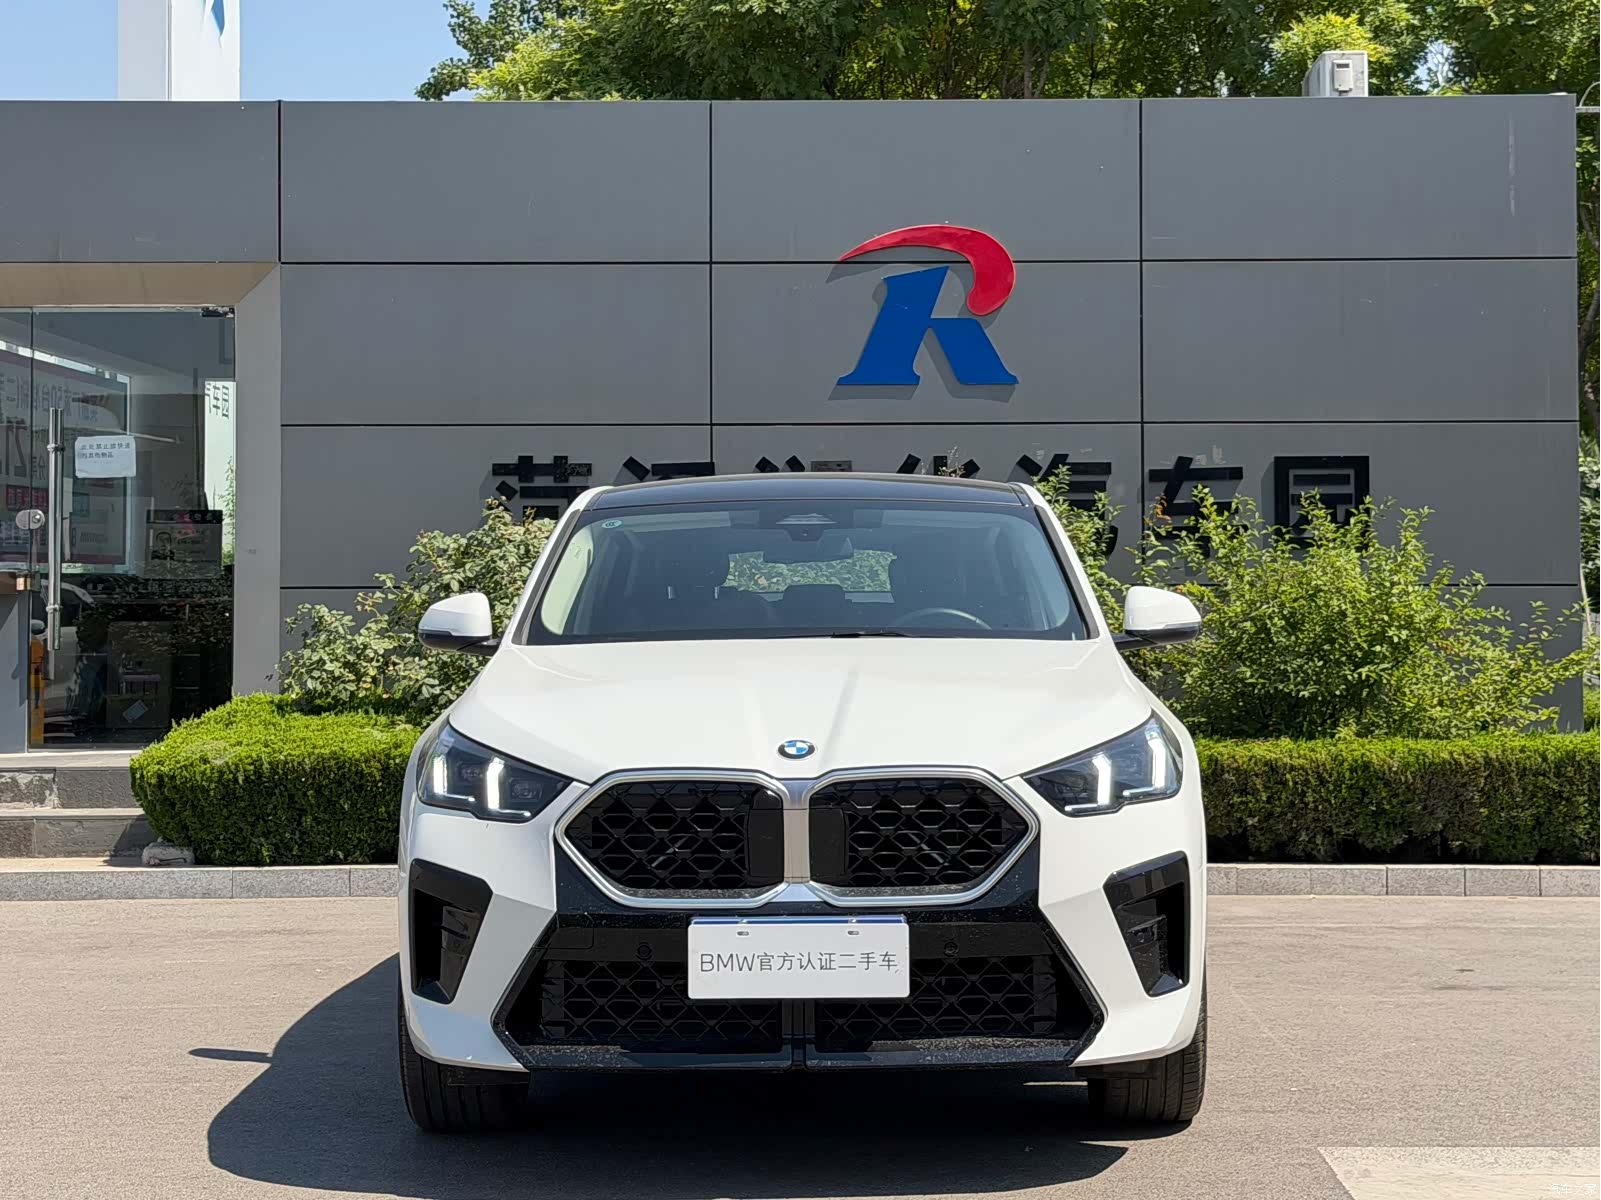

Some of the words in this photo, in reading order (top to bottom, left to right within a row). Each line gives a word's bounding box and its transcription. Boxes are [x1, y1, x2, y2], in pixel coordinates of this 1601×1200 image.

[700, 951, 898, 973] BMW官方认证二手车
